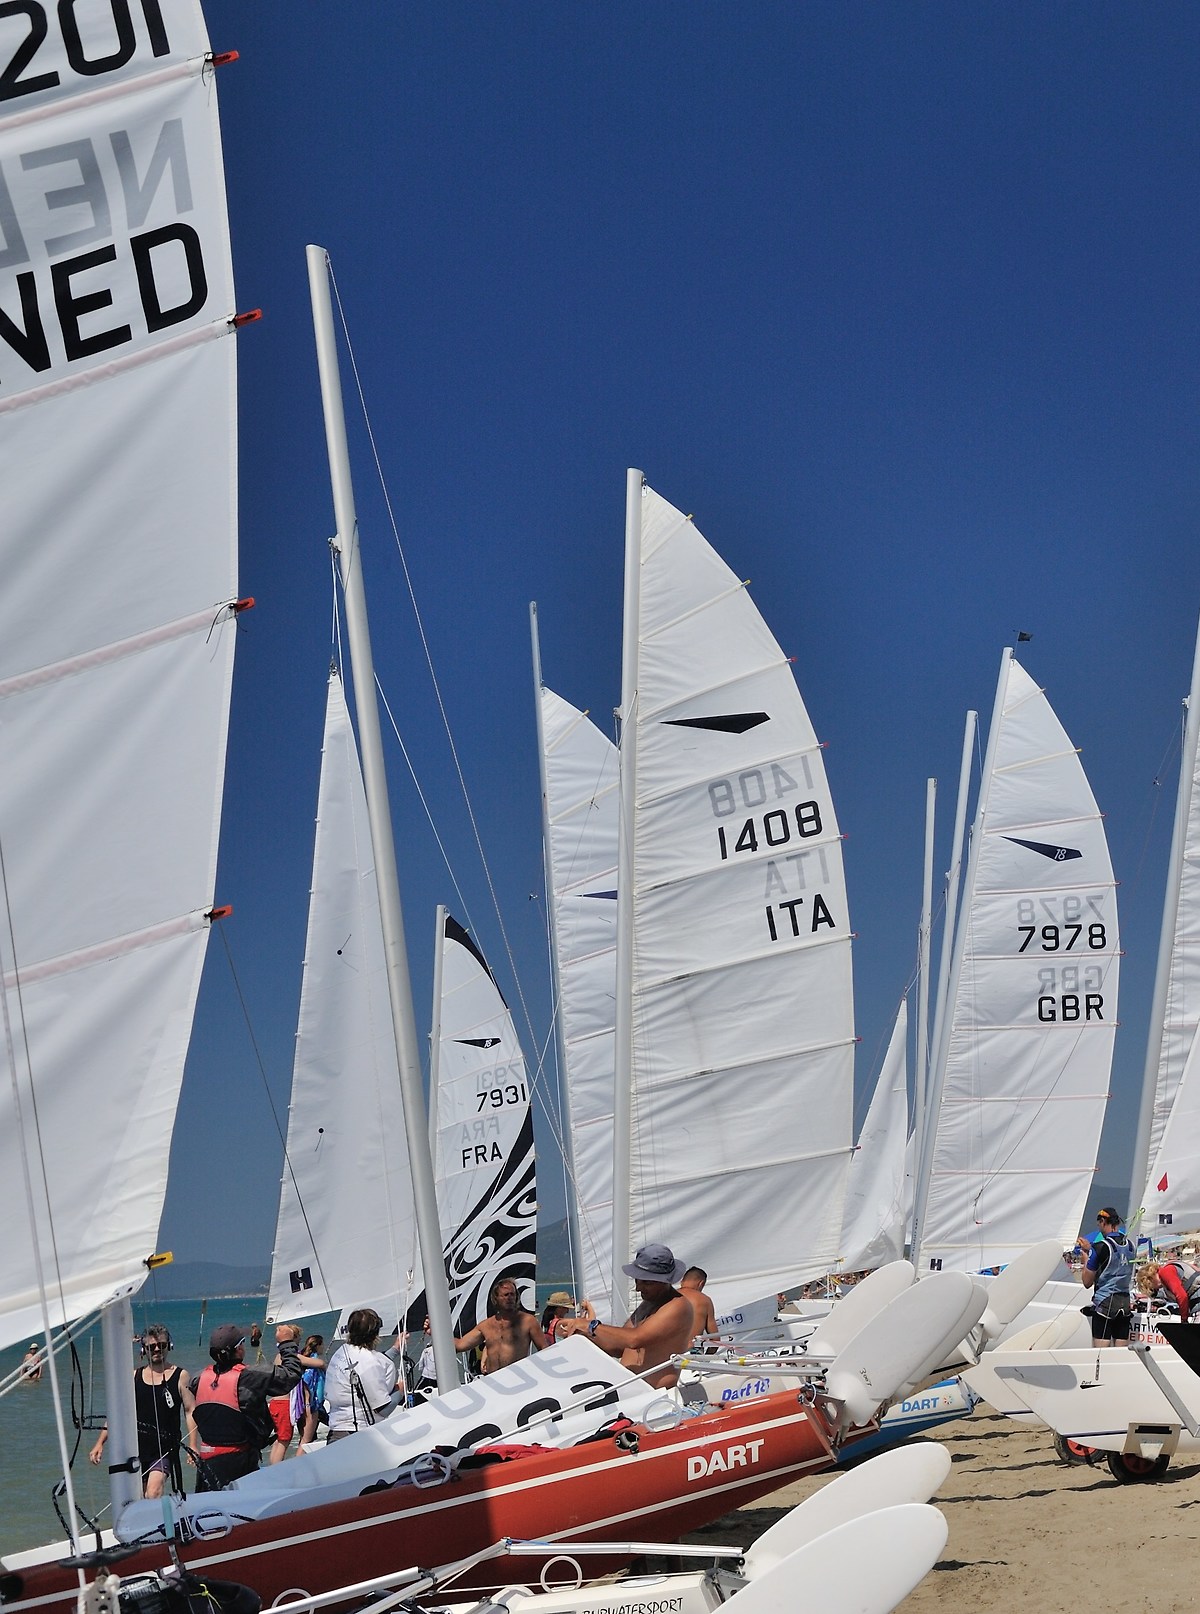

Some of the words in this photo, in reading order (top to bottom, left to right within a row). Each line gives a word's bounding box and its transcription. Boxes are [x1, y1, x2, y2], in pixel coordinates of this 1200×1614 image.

[717, 800, 823, 860] 1408
[765, 893, 836, 941] ITA
[1018, 923, 1107, 953] 7978
[1037, 994, 1104, 1022] GBR
[476, 1083, 527, 1113] 7931
[461, 1141, 503, 1169] FRA
[721, 1382, 752, 1401] Dart
[901, 1396, 940, 1413] DART
[687, 1438, 765, 1482] DART
